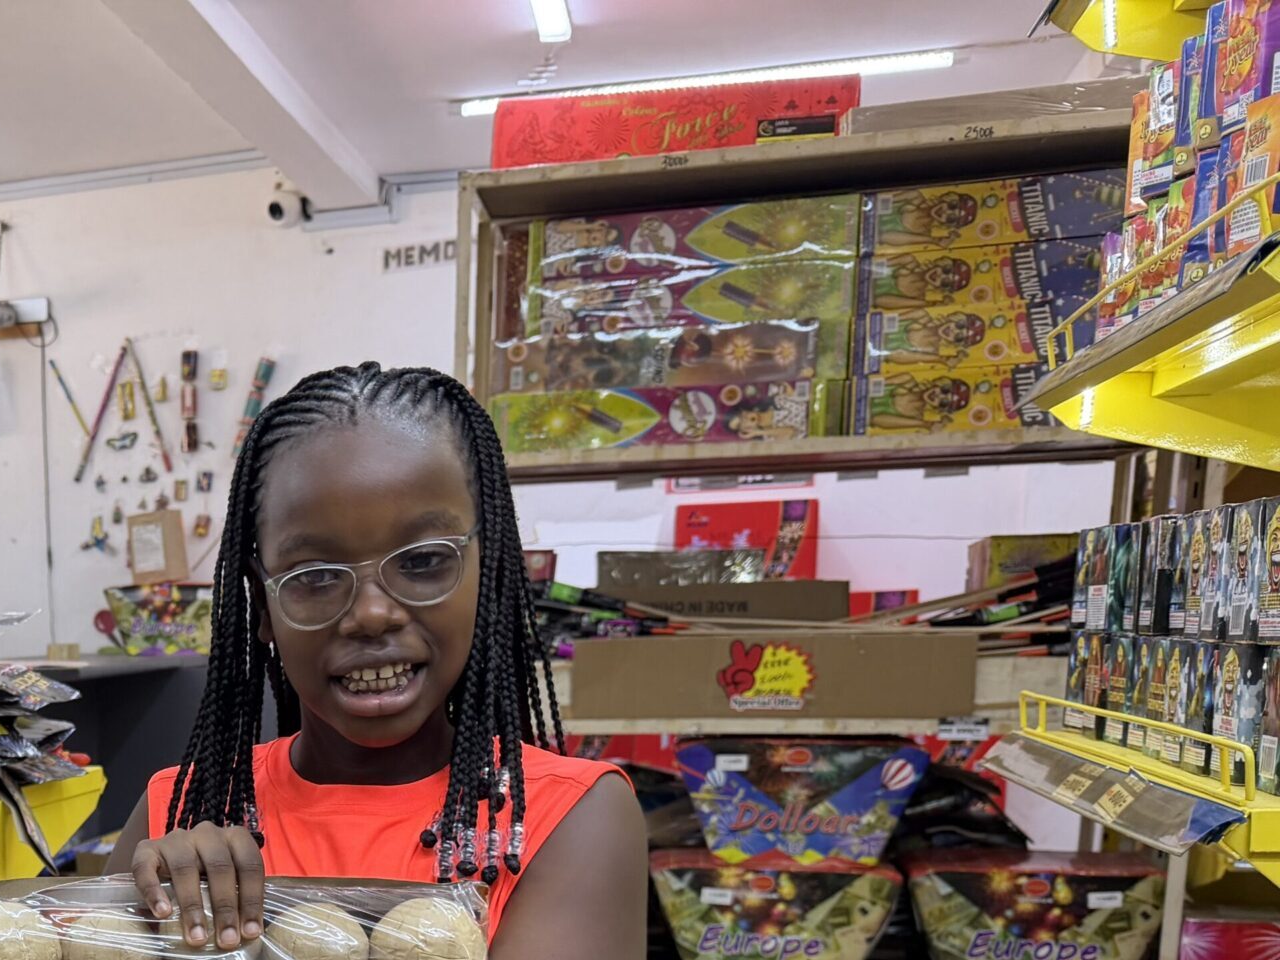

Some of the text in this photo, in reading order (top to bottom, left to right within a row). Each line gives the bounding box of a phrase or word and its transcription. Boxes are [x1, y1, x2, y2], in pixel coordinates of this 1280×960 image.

[1021, 182, 1049, 235] TITANIC
[1014, 248, 1042, 301] TITANIC
[1014, 369, 1043, 423] TITNIC
[729, 800, 861, 834] Dolloar
